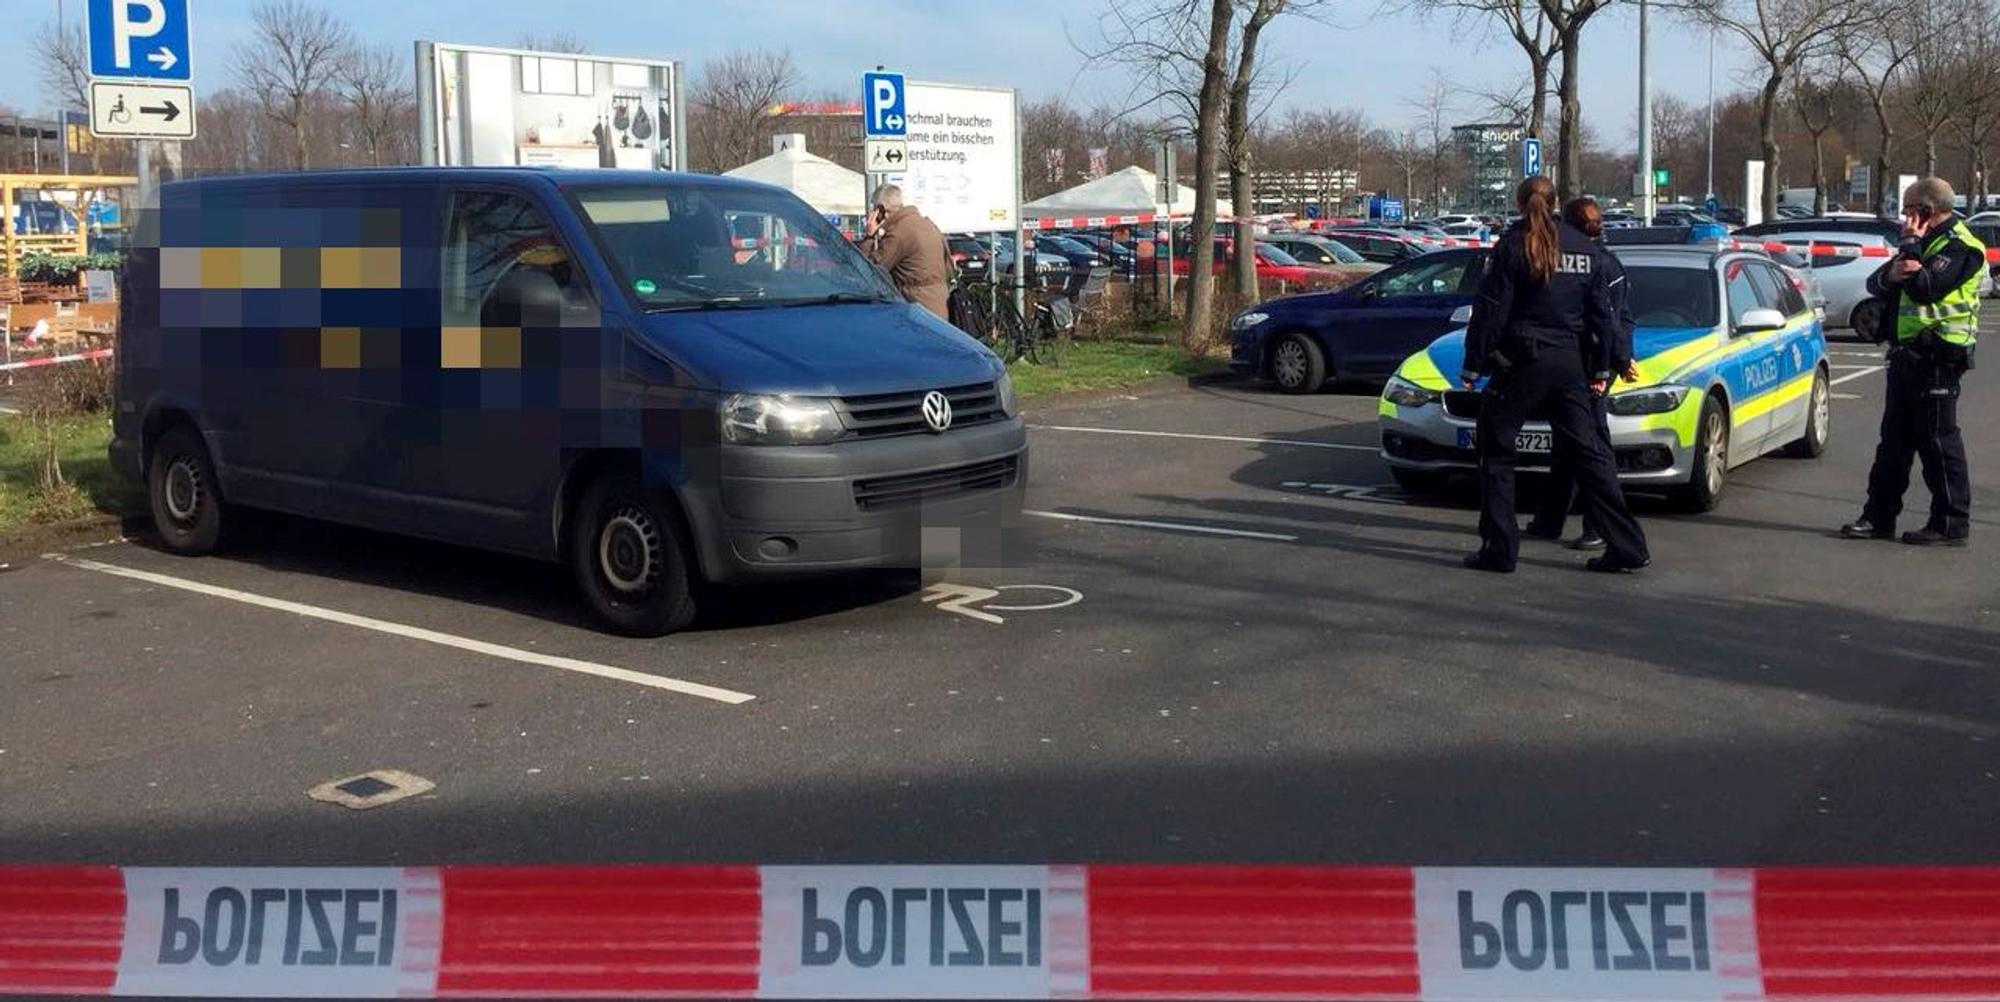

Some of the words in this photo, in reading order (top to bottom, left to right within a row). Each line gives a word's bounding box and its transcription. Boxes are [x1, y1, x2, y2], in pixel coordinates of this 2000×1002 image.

[112, 0, 166, 68] P
[874, 79, 897, 130] P
[906, 113, 944, 126] nchmal
[947, 114, 992, 127] brauchen
[906, 132, 930, 143] ume
[933, 131, 949, 143] ein
[951, 132, 994, 145] bisschen
[908, 148, 967, 164] erstützung.
[1528, 143, 1538, 173] P
[1554, 253, 1591, 273] LIZEI
[1744, 356, 1777, 391] POLIZEI
